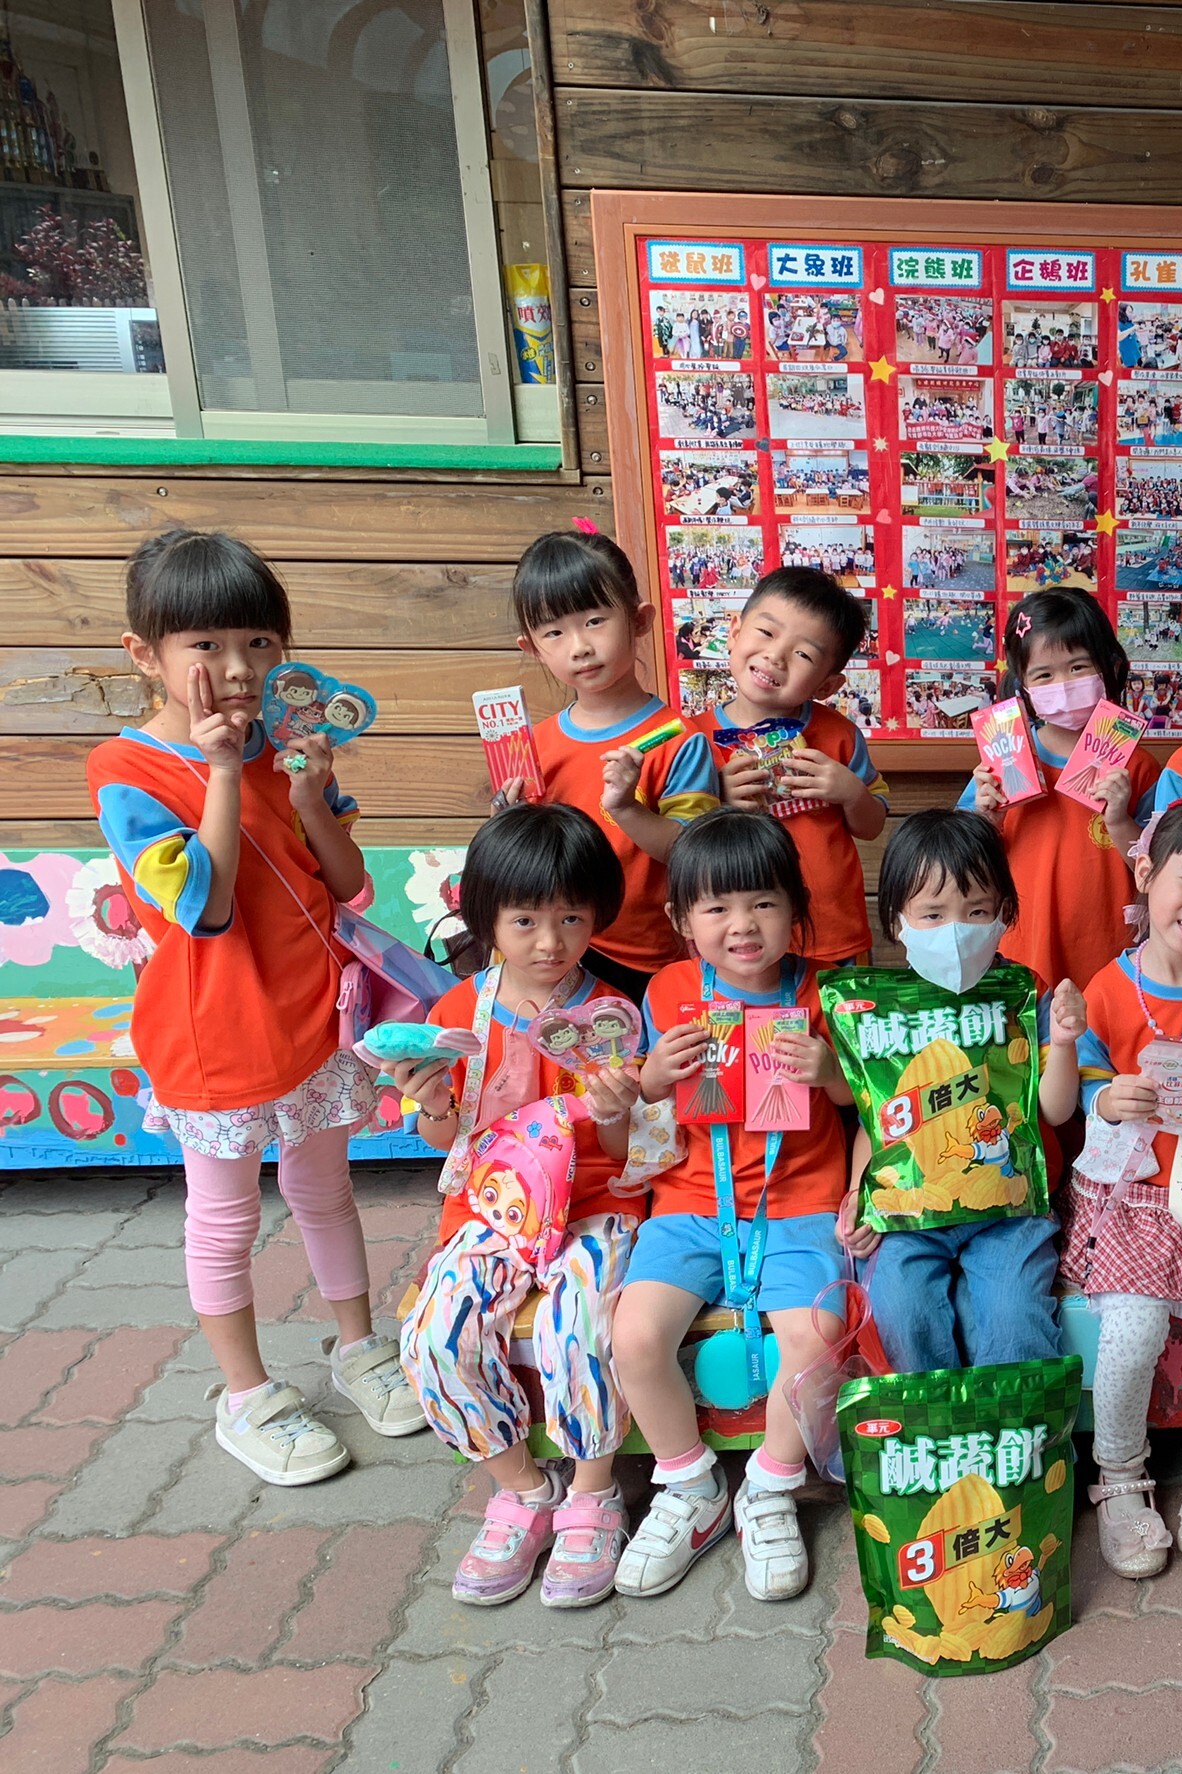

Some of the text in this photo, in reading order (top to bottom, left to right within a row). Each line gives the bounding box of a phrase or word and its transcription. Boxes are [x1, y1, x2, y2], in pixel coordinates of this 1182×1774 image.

[657, 251, 735, 274] 袋鼠班
[776, 252, 855, 278] 大象班
[897, 255, 974, 281] 浣熊班
[1013, 257, 1089, 282] 企鵝班
[477, 699, 520, 721] CITY
[857, 1001, 1008, 1060] 鹹蔬餅
[886, 1073, 980, 1137] 3 倍大
[715, 1137, 727, 1183] BULBASAUR
[748, 1229, 762, 1276] BULBASAUR
[866, 1422, 890, 1434] 華元
[879, 1424, 1048, 1495] 鹹蔬餅
[906, 1517, 1012, 1582] 3 倍大
